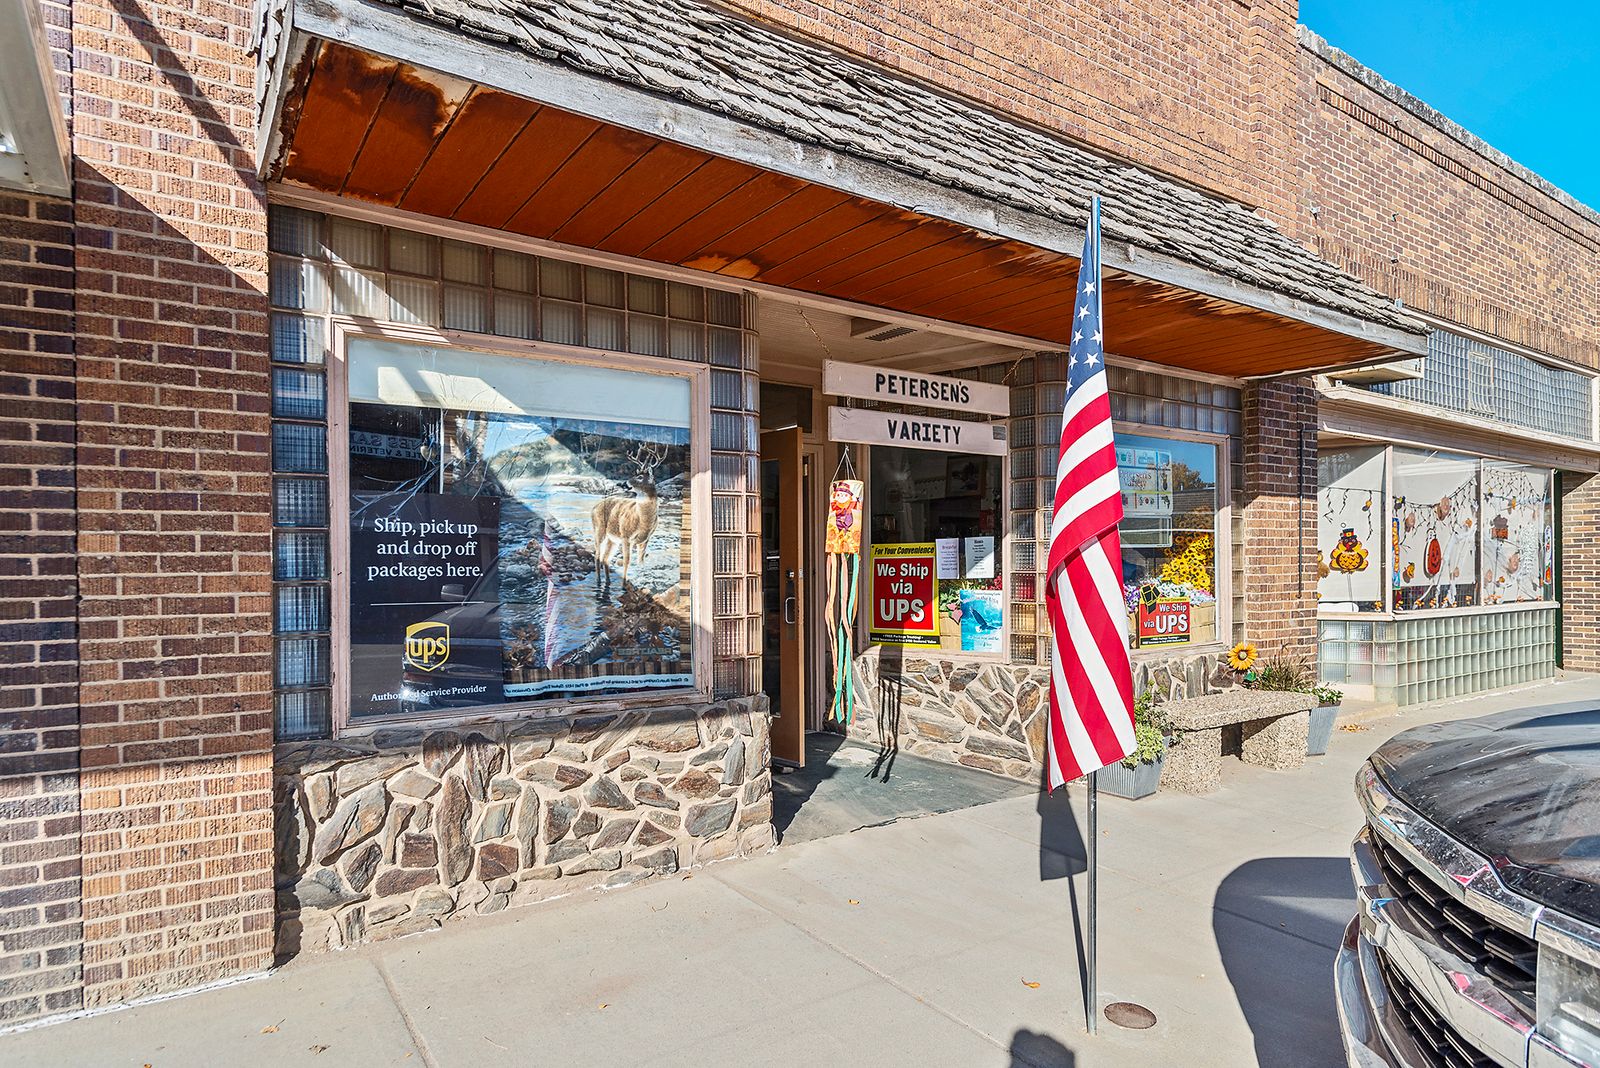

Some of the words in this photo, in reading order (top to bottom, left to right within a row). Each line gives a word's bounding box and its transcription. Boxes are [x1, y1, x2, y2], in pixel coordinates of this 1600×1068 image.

[876, 373, 969, 403] PETERSEN'S
[888, 419, 961, 444] VARIETY
[374, 517, 416, 537] Ship,
[420, 519, 455, 537] pick
[458, 523, 478, 538] up
[377, 540, 409, 555] and
[413, 540, 451, 559] drop
[455, 541, 478, 555] off
[875, 547, 883, 555] For
[897, 546, 935, 554] Convenience
[367, 562, 443, 581] packages
[446, 562, 484, 577] here.
[877, 563, 896, 577] We
[900, 562, 929, 580] Ship
[891, 579, 913, 594] via
[880, 598, 925, 622] UPS
[1159, 603, 1170, 612] We
[1171, 602, 1187, 612] Ship
[1143, 619, 1155, 628] via
[1155, 613, 1188, 633] UPS
[410, 636, 447, 664] ups
[371, 690, 420, 701] Authored
[420, 688, 451, 697] Service
[452, 685, 487, 694] Provider
